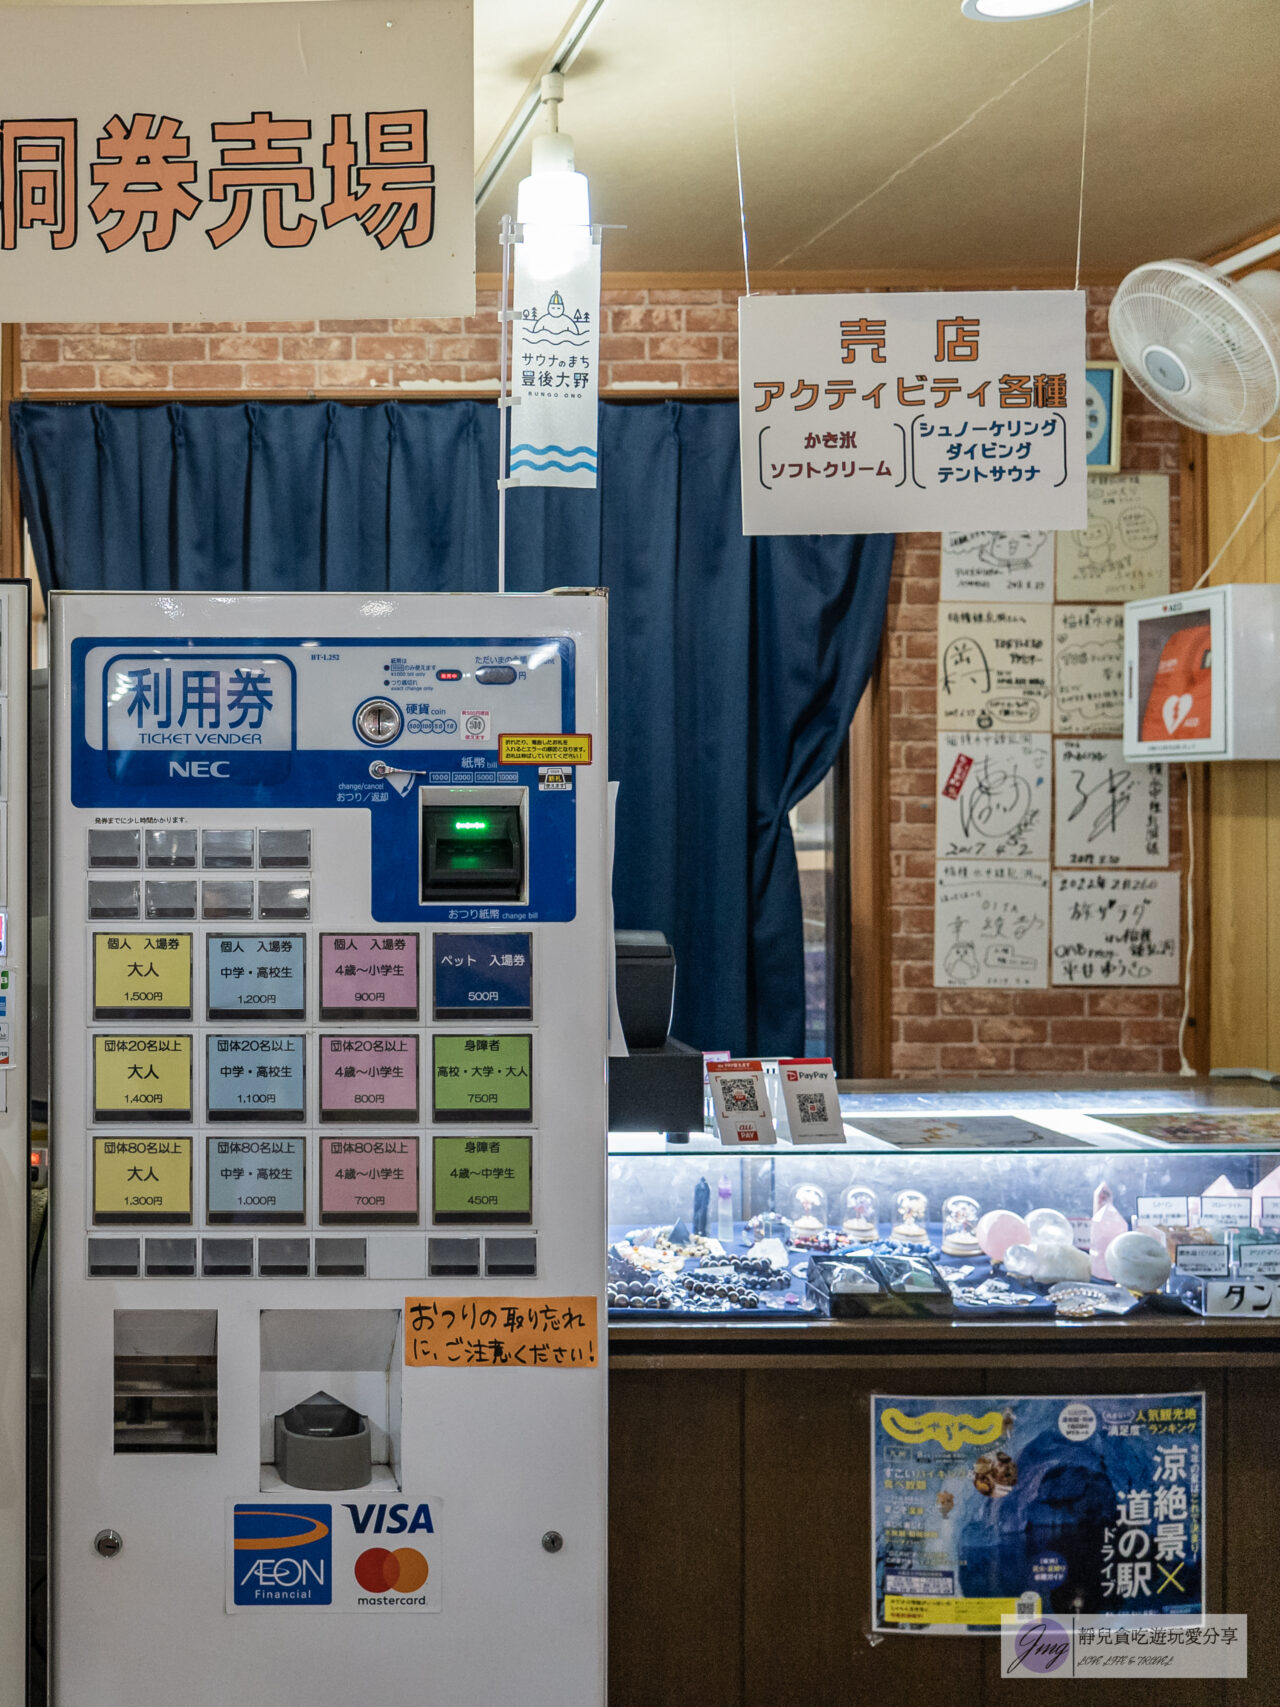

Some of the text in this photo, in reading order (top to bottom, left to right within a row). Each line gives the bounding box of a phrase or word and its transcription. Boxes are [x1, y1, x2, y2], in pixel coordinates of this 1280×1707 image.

[521, 353, 590, 368] サウナのまち
[521, 370, 589, 389] 豊後大野
[753, 374, 1067, 412] アクティビティ各種
[920, 419, 1057, 437] シュノーケリング
[804, 431, 858, 450] かき氷
[946, 442, 1031, 461] ダイビング
[771, 461, 892, 478] ソフトクリーム
[938, 465, 1040, 483] テントサウナ
[518, 671, 527, 680] 円
[127, 668, 273, 729] 利用券
[406, 704, 446, 715] 硬貨 coin
[138, 733, 262, 744] TICKET VENDER
[170, 761, 230, 778] NEC
[461, 757, 498, 769] 紙幣 bill
[338, 783, 384, 791] change/cancel
[448, 909, 538, 920] おつり紙幣 change bill
[107, 938, 180, 951] 個人 入場券
[220, 941, 292, 953] 個人 入場券
[334, 938, 406, 951] 個人 入場券
[441, 954, 525, 967] ペット 入場券
[127, 962, 159, 977] 大人
[220, 966, 292, 979] 中学・高校生
[354, 992, 385, 1002] 900円
[468, 991, 499, 1002] 500円
[104, 1040, 182, 1052] 団体20名以上
[217, 1040, 295, 1052] 団体20名以上
[330, 1040, 408, 1052] 団体20名以上
[464, 1039, 500, 1052] 身障者
[127, 1064, 159, 1079] 大人
[220, 1066, 292, 1078] 中学・高校生
[437, 1065, 528, 1078] 高校・大学・大人
[798, 1070, 828, 1080] PayPay
[354, 1094, 385, 1104] 800円
[467, 1093, 498, 1104] 750円
[104, 1142, 182, 1155] 団体80名以上
[217, 1142, 295, 1155] 団体80名以上
[330, 1142, 408, 1155] 団体80名以上
[464, 1142, 500, 1154] 身障者
[127, 1166, 159, 1182] 大人
[220, 1168, 292, 1180] 中学・高校生
[354, 1196, 385, 1206] 700円
[467, 1196, 498, 1206] 450円
[1224, 1285, 1280, 1312] タン
[411, 1302, 585, 1333] おつりの取り忘れ
[1136, 1408, 1196, 1423] 人気観光地
[341, 1503, 434, 1534] VISA
[1116, 1489, 1152, 1599] 道の駅
[1101, 1527, 1117, 1597] ドライブ
[255, 1589, 312, 1599] Financial
[358, 1595, 426, 1606] mastercard
